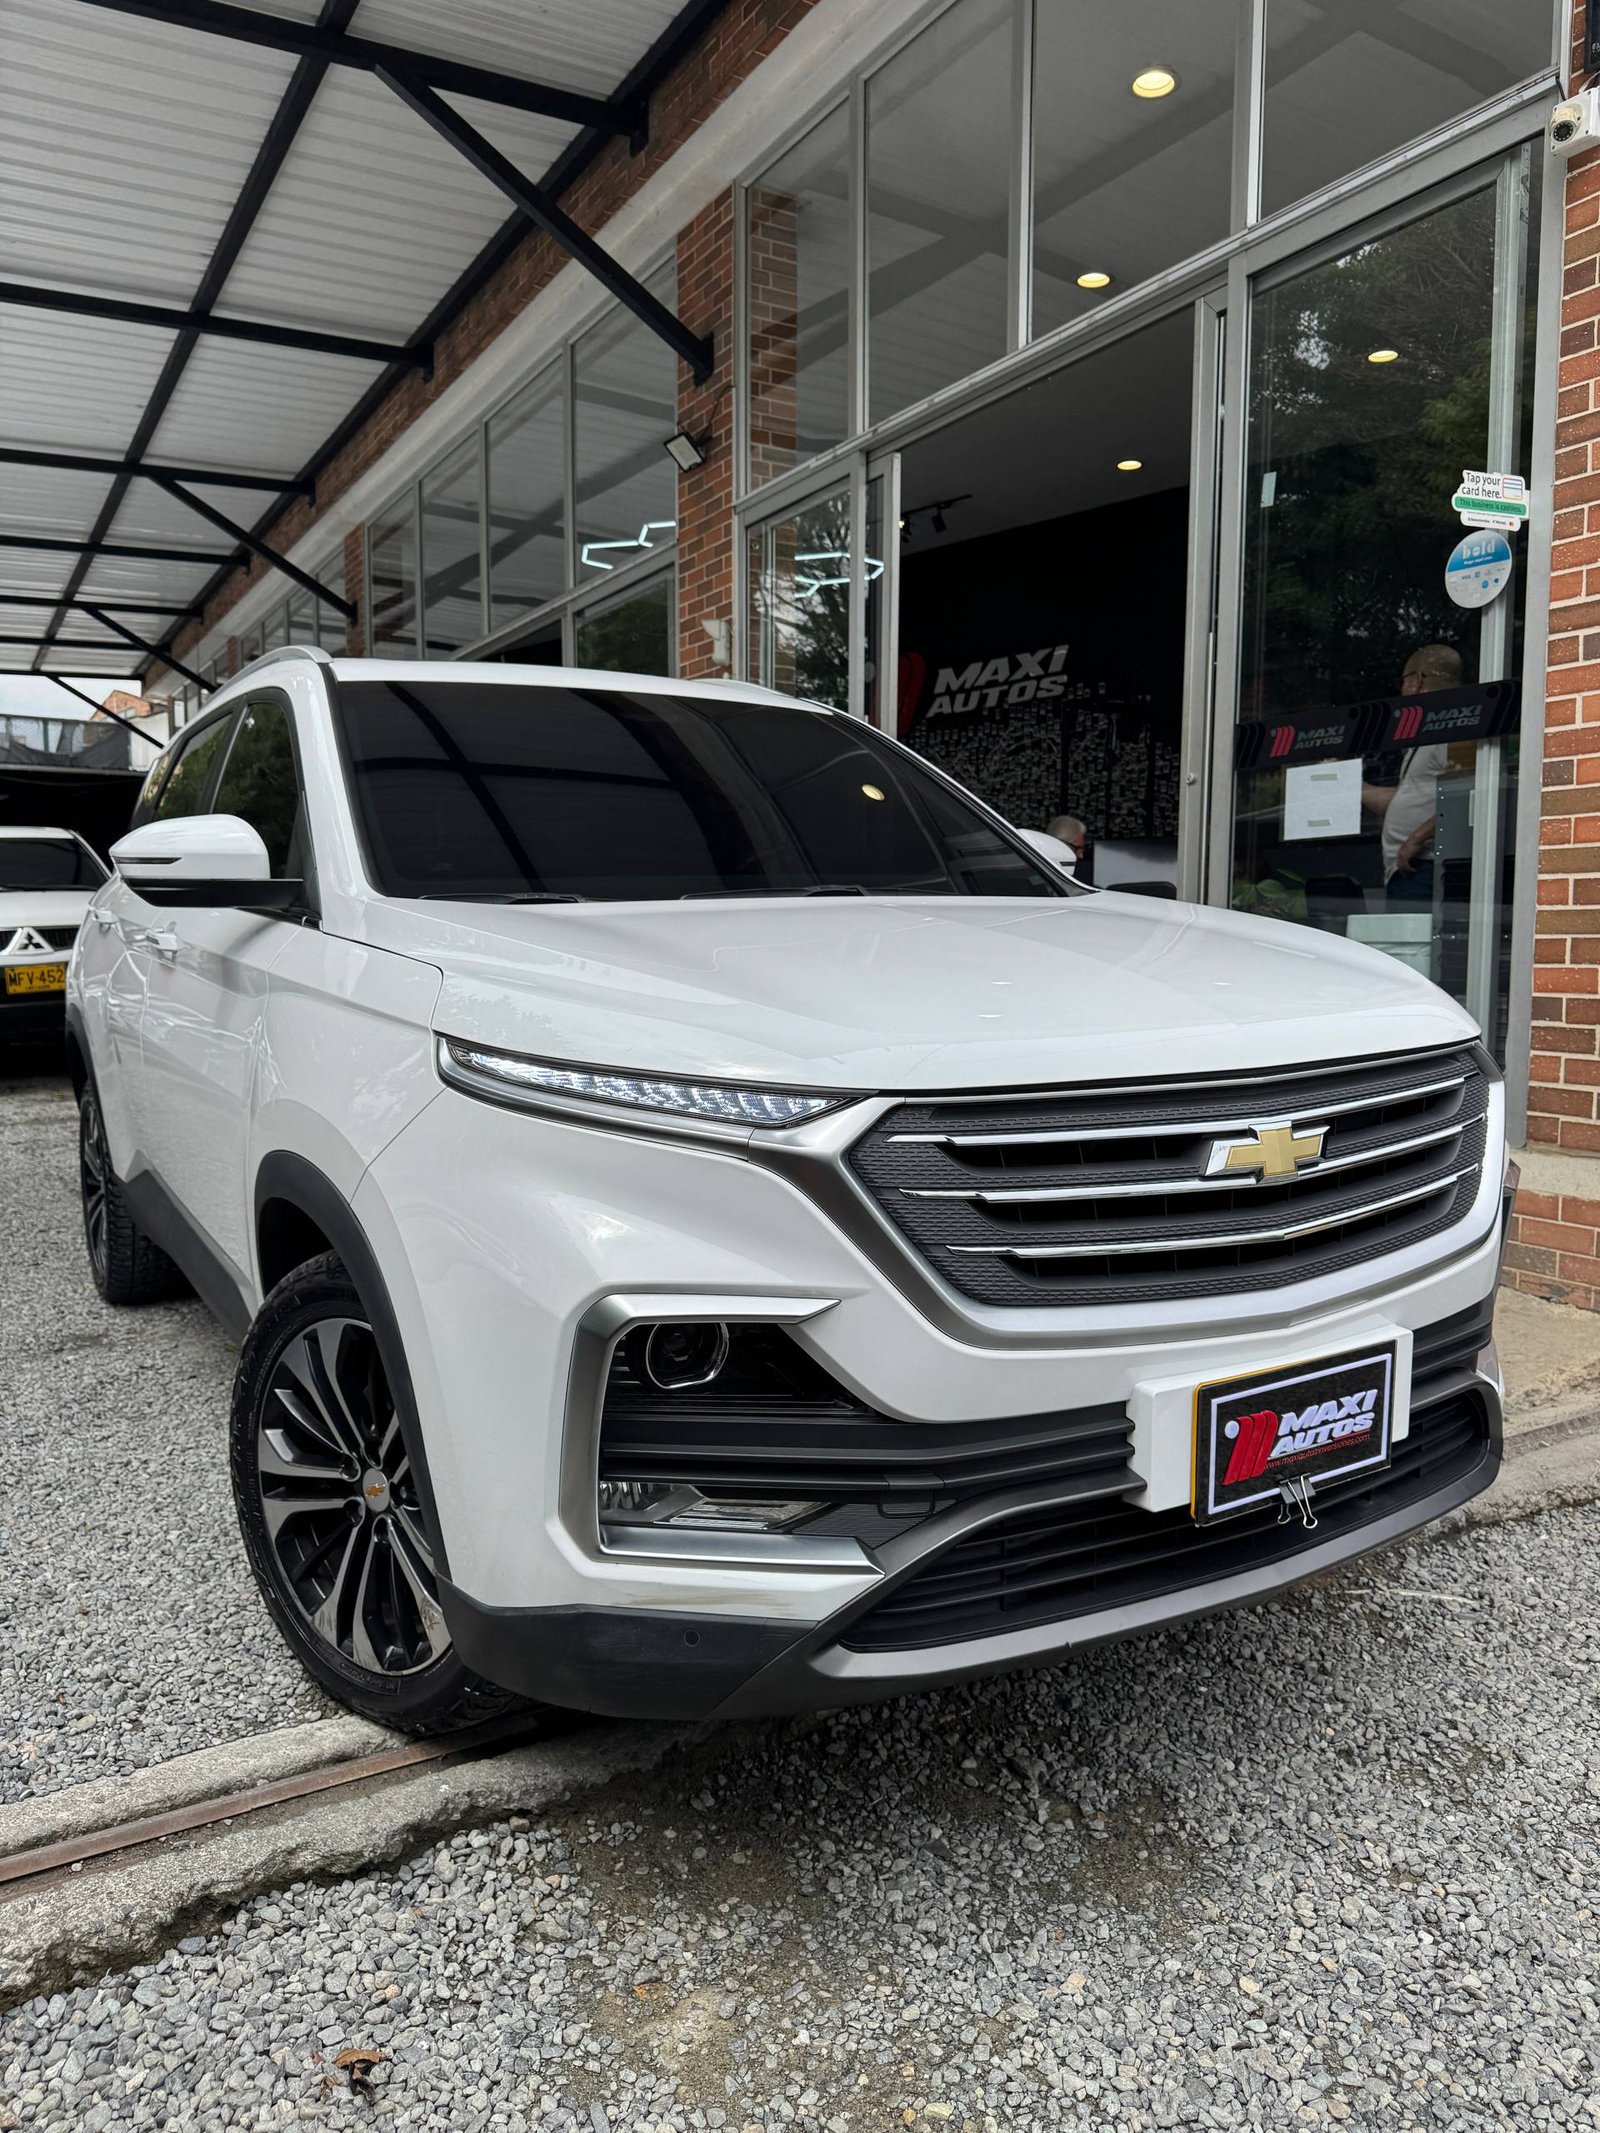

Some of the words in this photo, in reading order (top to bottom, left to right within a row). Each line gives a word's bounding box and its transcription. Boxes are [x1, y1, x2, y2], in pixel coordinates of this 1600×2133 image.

[1466, 472, 1481, 486] Tap
[1482, 475, 1501, 486] your
[1461, 486, 1480, 496] card
[1482, 487, 1502, 499] here.
[1460, 498, 1471, 506] This
[1471, 500, 1494, 510] business
[1462, 540, 1496, 560] bold
[933, 644, 1069, 694] MAXI
[925, 674, 1068, 718] AUTOS
[1425, 704, 1483, 722] MAXI
[1422, 715, 1481, 732] AUTOS
[1297, 724, 1346, 741] MAXI
[1293, 735, 1345, 750] AUTOS
[1278, 1389, 1378, 1436] MAXI
[1270, 1412, 1375, 1457] AUTOS
